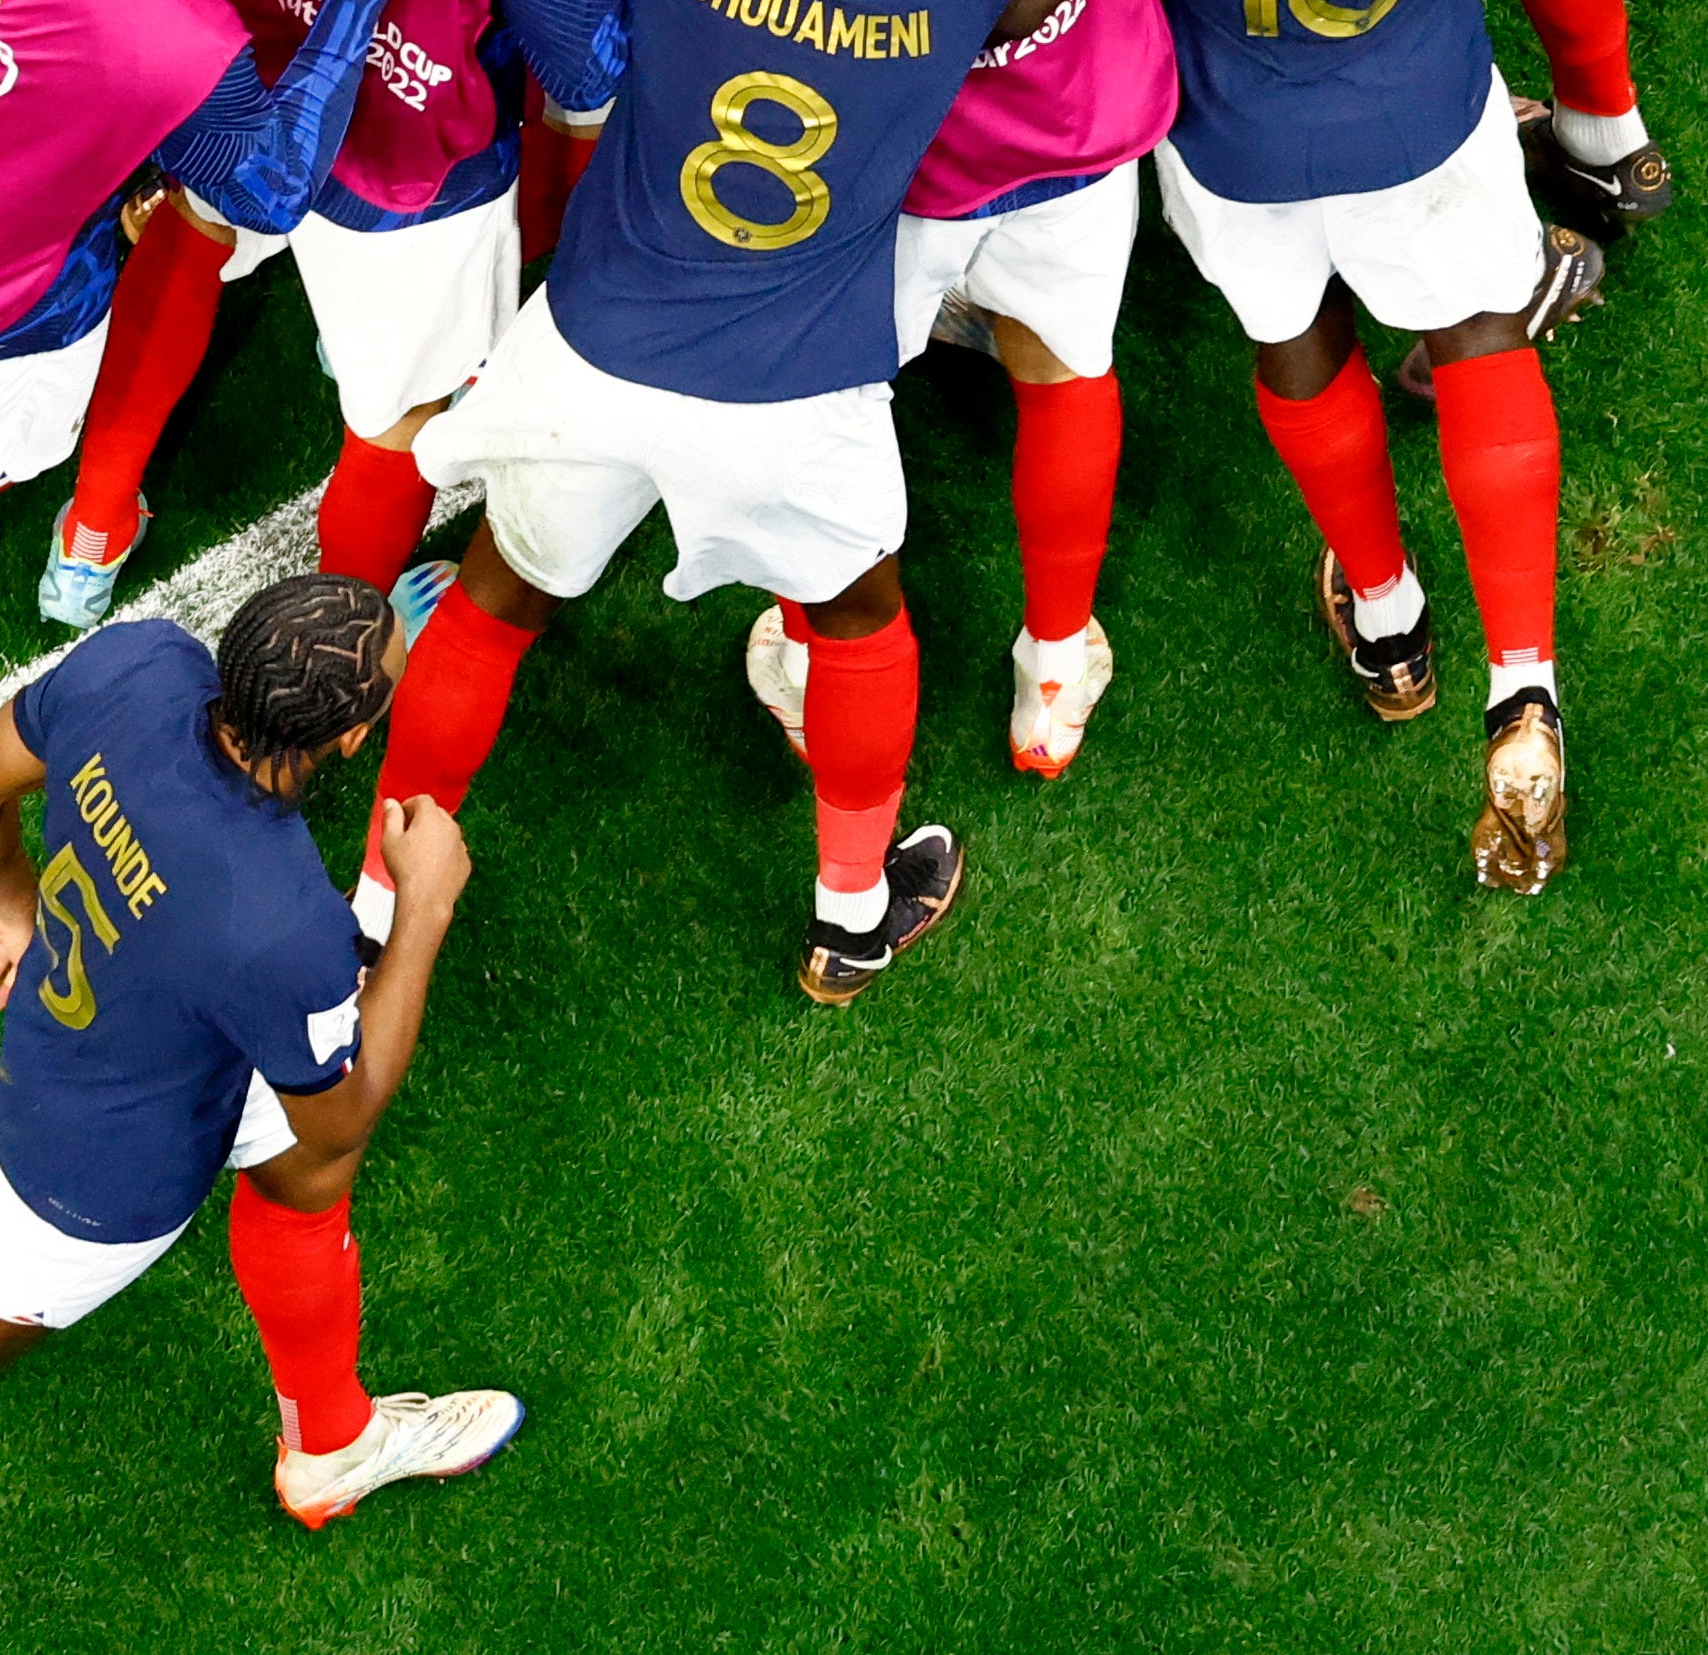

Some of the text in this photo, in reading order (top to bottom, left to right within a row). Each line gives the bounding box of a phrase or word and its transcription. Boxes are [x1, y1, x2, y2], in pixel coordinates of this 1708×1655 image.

[365, 42, 428, 112] 2022
[400, 42, 453, 86] CUP
[679, 70, 839, 251] 8
[70, 752, 168, 921] KOUNDE
[36, 841, 121, 1031] 5
